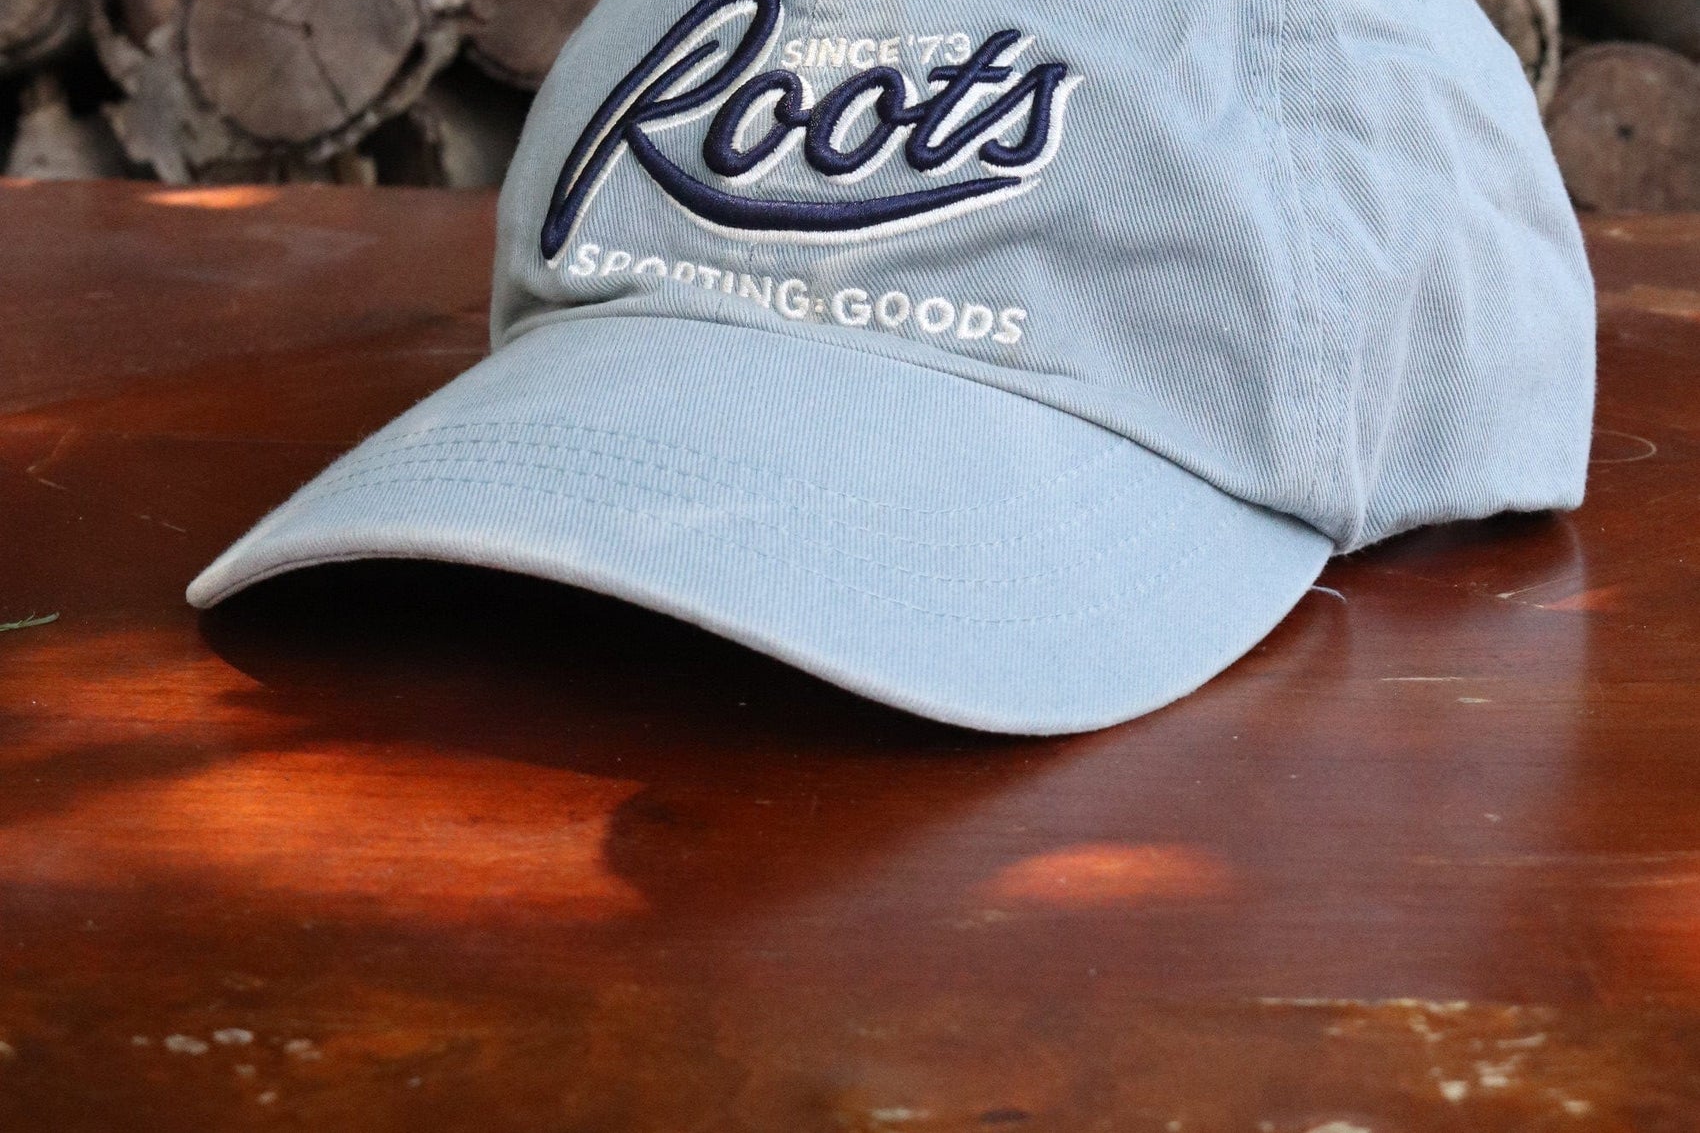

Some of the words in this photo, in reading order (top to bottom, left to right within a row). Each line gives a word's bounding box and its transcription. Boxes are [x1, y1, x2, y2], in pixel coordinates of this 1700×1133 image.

[781, 35, 900, 70] SINCE
[908, 32, 972, 65] '73
[832, 287, 1027, 344] GOODS
